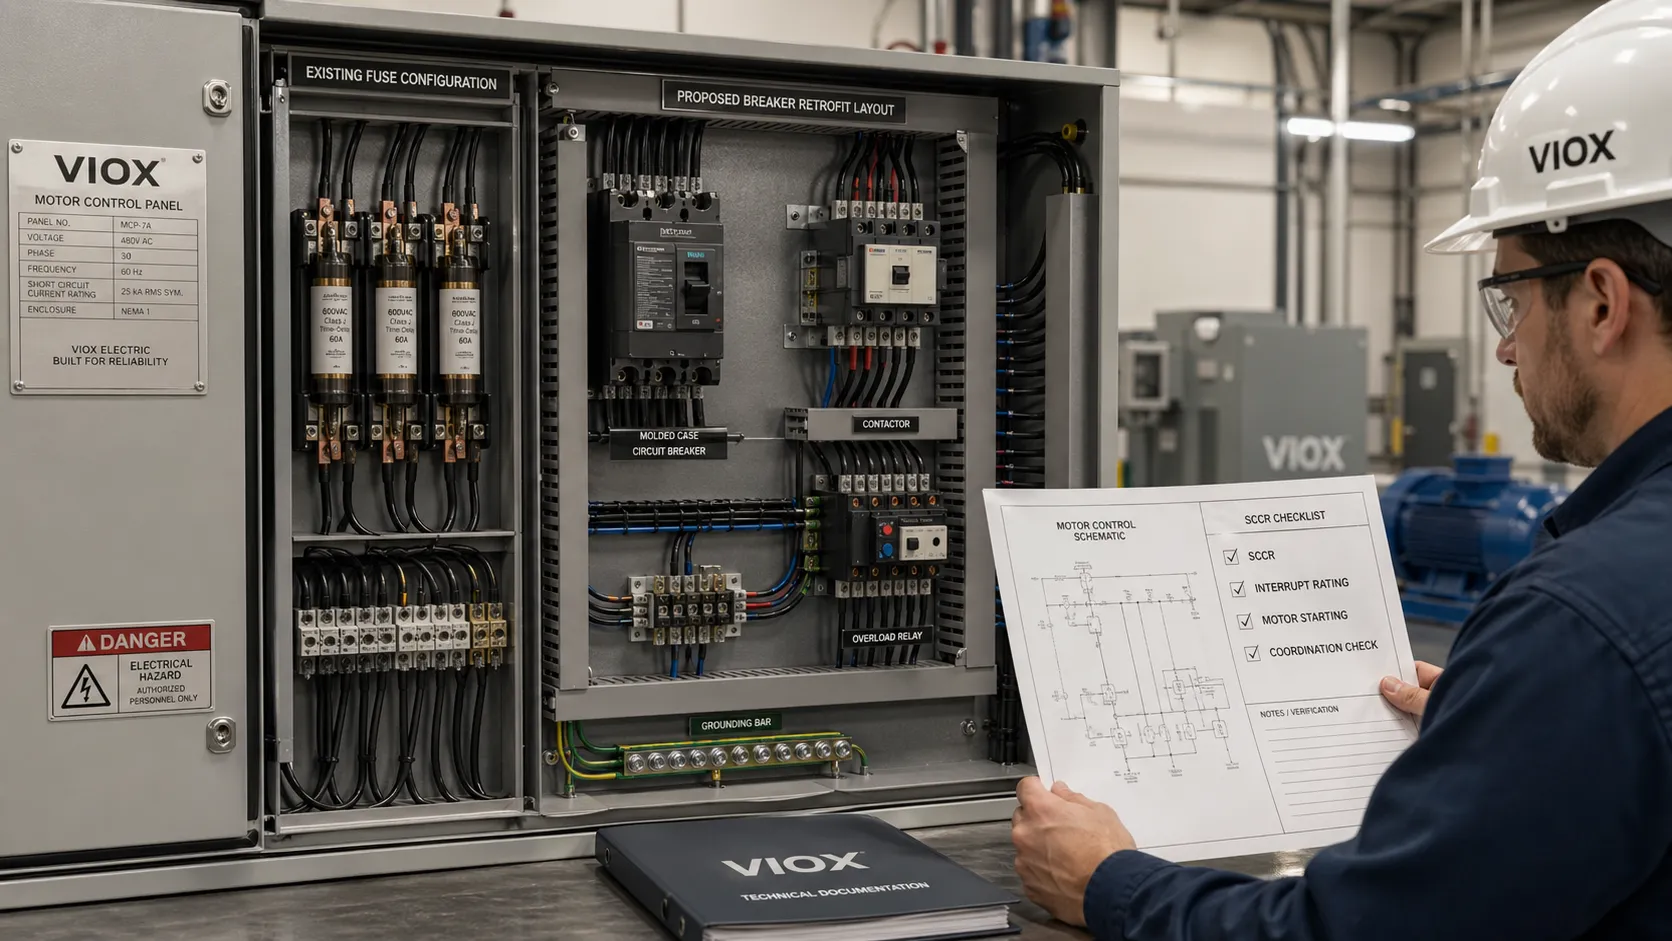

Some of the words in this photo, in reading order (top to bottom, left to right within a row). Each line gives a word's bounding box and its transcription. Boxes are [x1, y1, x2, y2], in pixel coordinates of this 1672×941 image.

[306, 65, 363, 82] EXISTING
[366, 69, 398, 84] FUSE
[400, 71, 498, 91] CONFIGURATION
[677, 89, 740, 106] PROPOSED
[743, 94, 796, 110] BREAKER
[798, 98, 851, 113] RETROFIT
[853, 102, 895, 116] LAYOUT
[1528, 129, 1616, 174] VIOX
[35, 194, 80, 207] MOTOR
[84, 197, 142, 210] CONTROL
[145, 200, 183, 212] PANEL
[27, 217, 53, 227] PANEL
[56, 219, 71, 227] NO.
[120, 221, 152, 230] MCP-7A
[27, 233, 64, 243] VOLTAGE
[120, 237, 140, 245] 480V
[142, 238, 154, 246] AC
[27, 249, 55, 258] PHASE
[27, 265, 77, 274] FREQUENCY
[120, 268, 131, 276] 60
[133, 268, 142, 276] Hz
[58, 281, 90, 289] CIRCUIT
[27, 290, 65, 298] CURRENT
[68, 290, 96, 299] RATING
[121, 288, 131, 296] 25
[133, 288, 143, 296] kA
[145, 288, 162, 296] RMS
[164, 289, 184, 297] SYM.
[27, 305, 76, 314] ENCLOSURE
[329, 335, 343, 343] 60A
[72, 346, 97, 354] VIOX
[100, 346, 151, 355] ELECTRIC
[53, 357, 82, 366] BUILT
[85, 357, 106, 366] FOR
[108, 357, 169, 367] RELIABILITY
[862, 419, 910, 429] CONTACTOR
[639, 431, 675, 440] MOLDED
[677, 431, 699, 440] CASE
[632, 446, 666, 456] CIRCUIT
[667, 446, 706, 456] BREAKER
[1262, 434, 1346, 472] VIOX
[1244, 514, 1271, 525] SCCR
[1273, 510, 1326, 523] CHECKLIST
[1056, 521, 1090, 531] MOTOR
[1092, 520, 1136, 530] CONTROL
[1074, 531, 1126, 541] SCHEMATIC
[1248, 550, 1276, 561] SCCR
[1254, 580, 1310, 593] INTERRUPT
[1313, 577, 1349, 589] RATING
[1262, 613, 1299, 626] MOTOR
[1300, 610, 1349, 623] STARTING
[100, 631, 187, 650] DANGER
[852, 632, 896, 644] OVERLOAD
[898, 631, 924, 641] RELAY
[1269, 643, 1343, 657] COORDINATION
[1345, 640, 1379, 652] CHECK
[130, 659, 193, 671] ELECTRICAL
[139, 670, 182, 682] HAZARD
[136, 685, 186, 694] AUTHORIZED
[129, 696, 175, 706] PERSONNEL
[177, 694, 198, 703] ONLY
[1260, 709, 1285, 718] NOTES
[1290, 705, 1340, 716] VERIFICATION
[701, 719, 753, 730] GROUNDING
[754, 718, 772, 727] BAR
[740, 891, 818, 902] TECHNICAL
[818, 881, 930, 897] DOCUMENTATION
